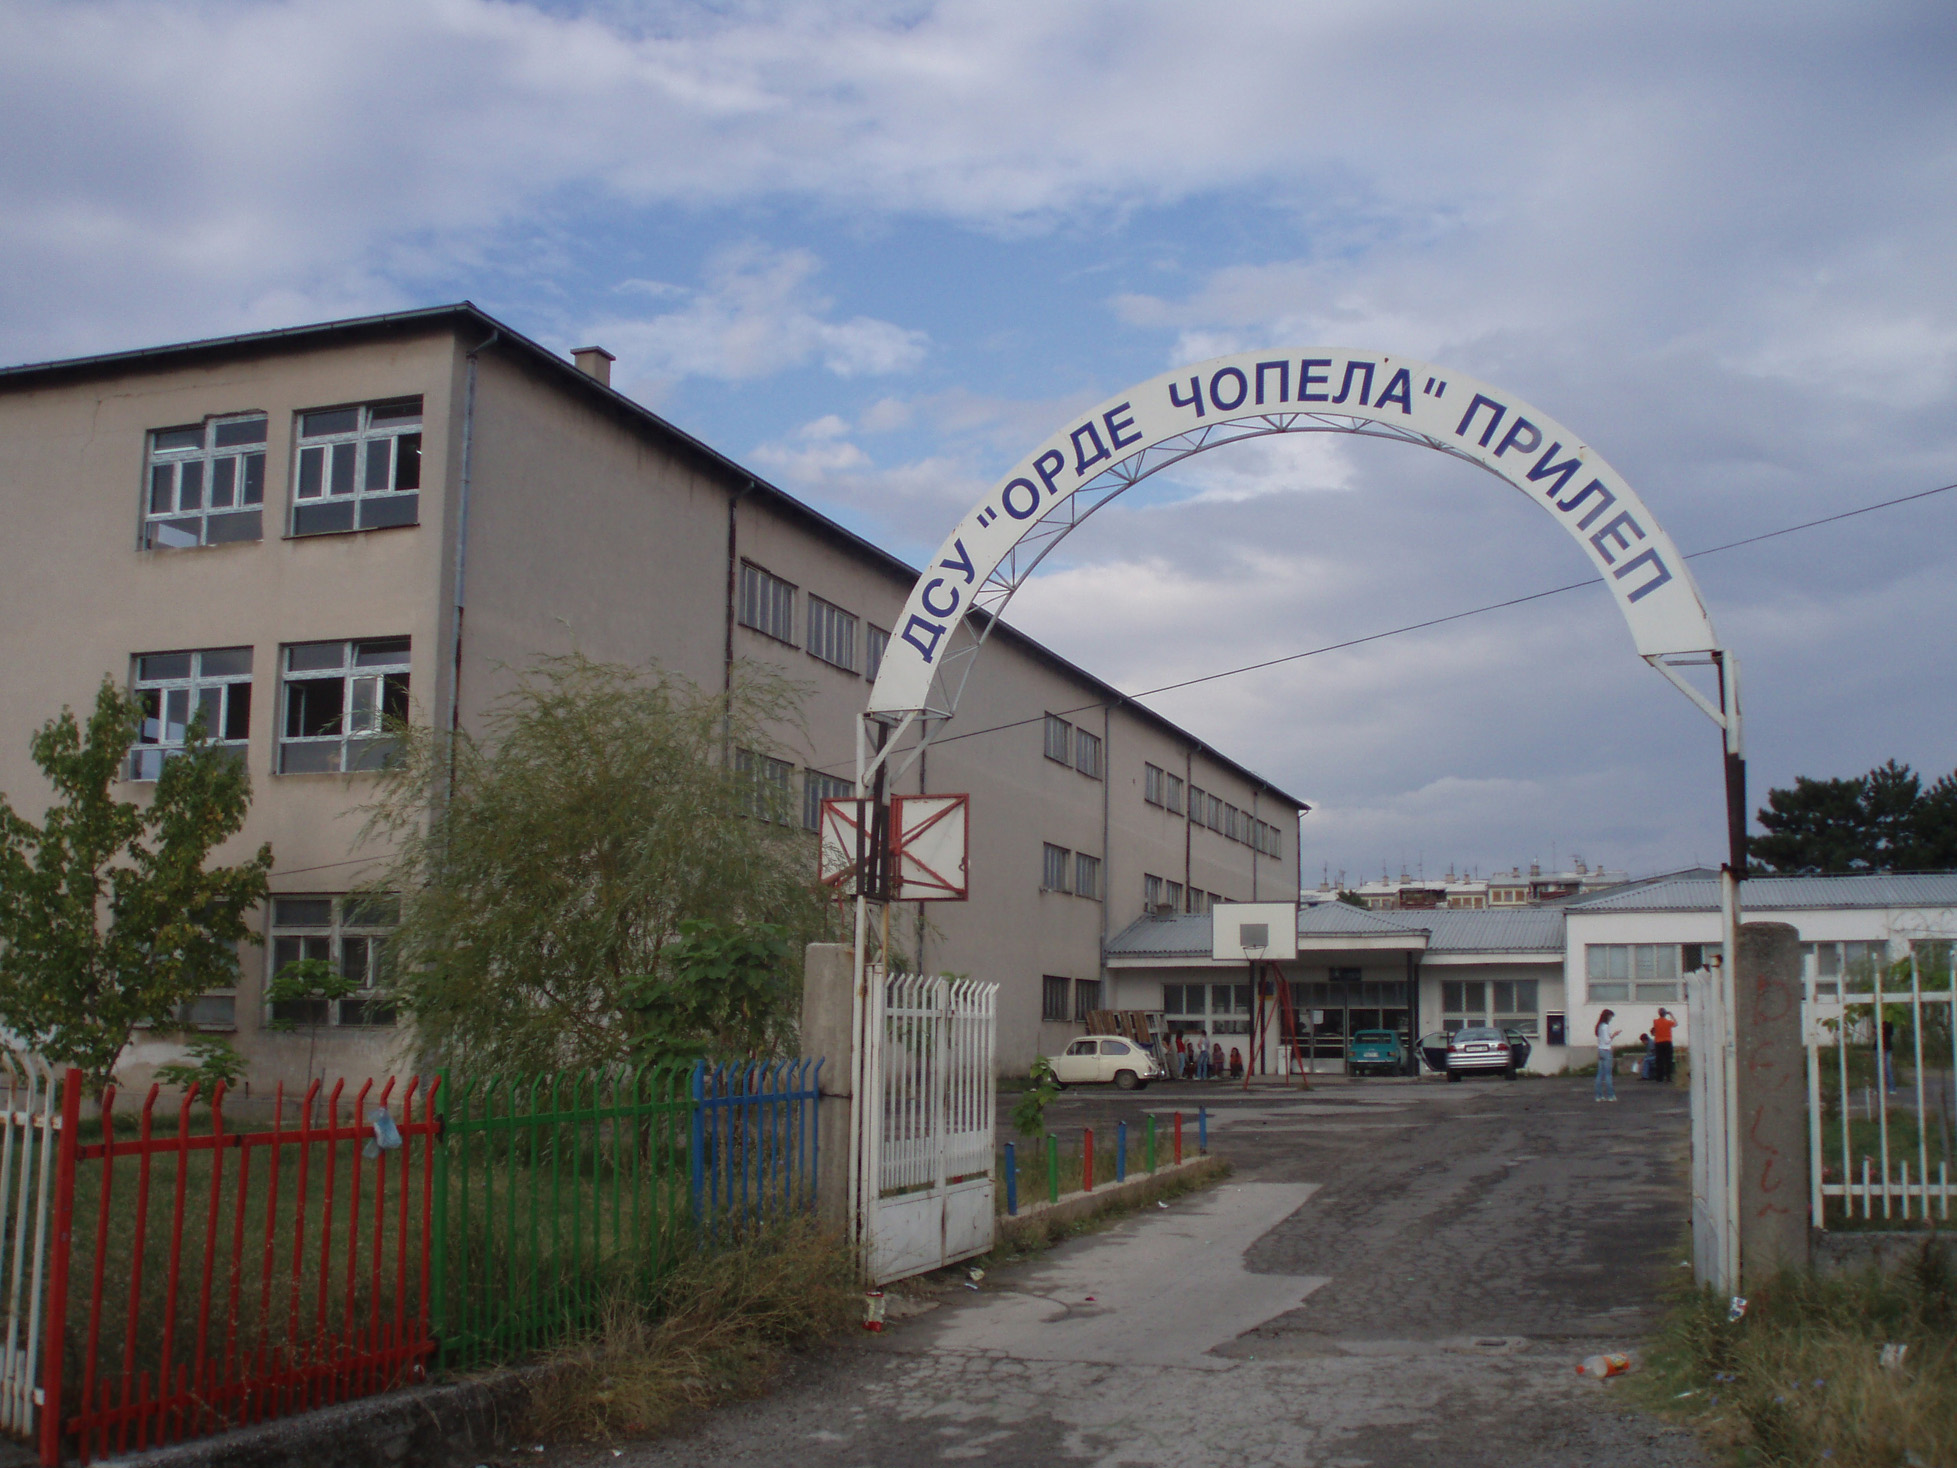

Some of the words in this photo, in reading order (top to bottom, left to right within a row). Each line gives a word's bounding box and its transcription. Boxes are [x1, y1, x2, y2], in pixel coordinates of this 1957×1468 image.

[901, 537, 975, 664] ДСУ
[976, 401, 1143, 528] "ОРДЕ
[1168, 359, 1447, 418] ЧОПЕЛА"
[1455, 393, 1673, 604] ПРИЛЕП
